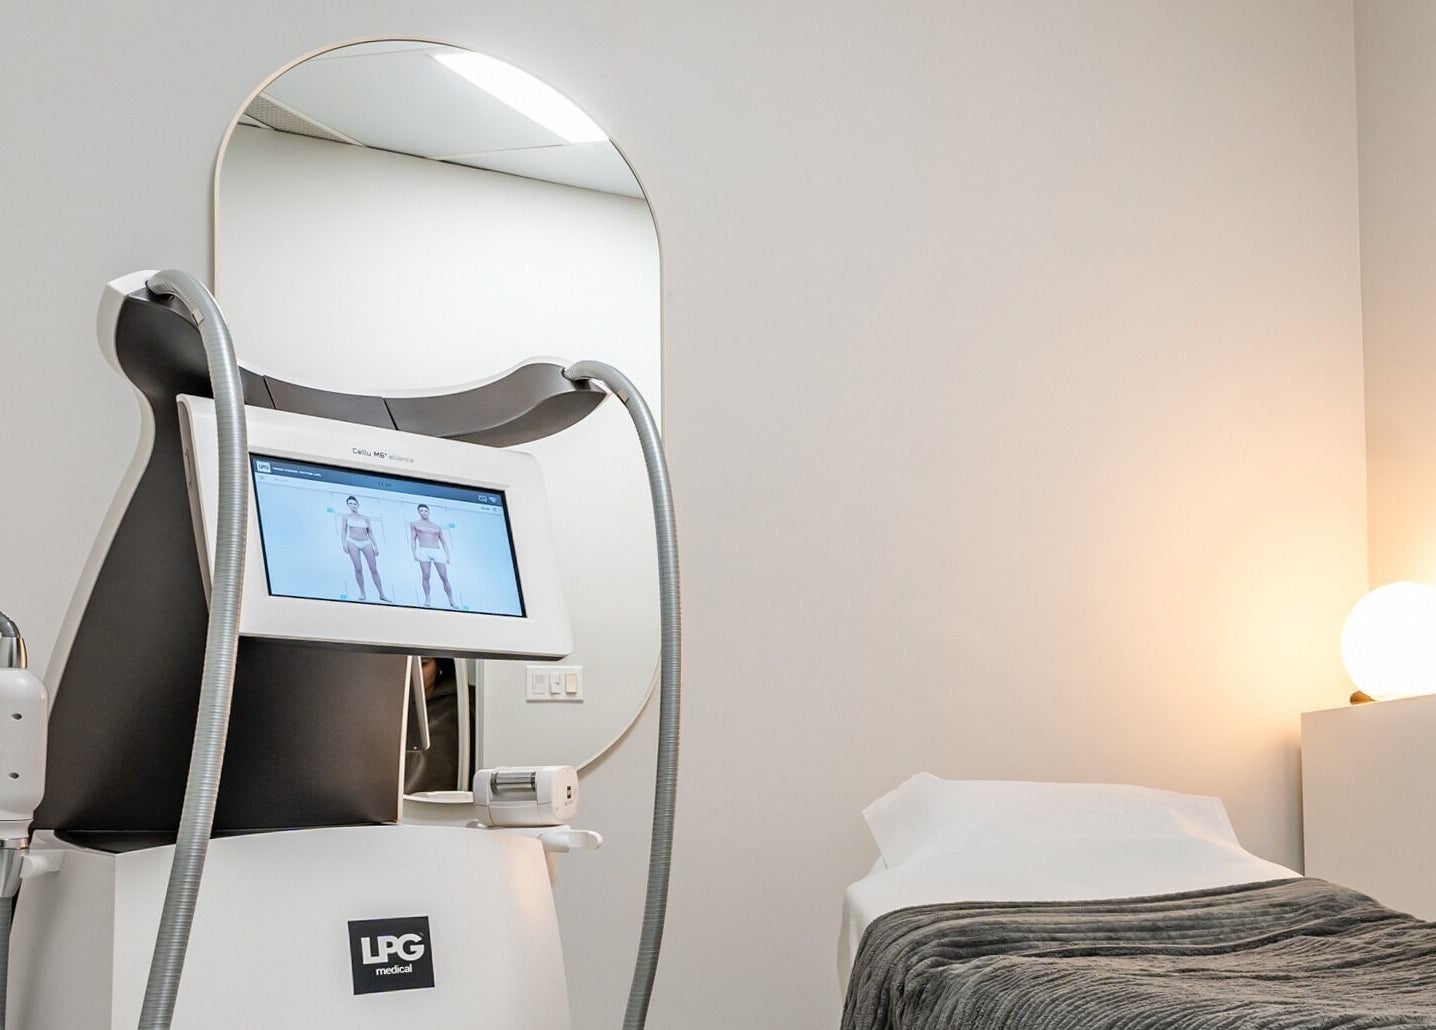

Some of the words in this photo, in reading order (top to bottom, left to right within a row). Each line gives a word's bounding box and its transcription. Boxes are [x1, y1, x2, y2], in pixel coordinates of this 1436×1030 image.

[352, 447, 372, 457] Cellu
[361, 933, 425, 965] LPG
[375, 963, 413, 976] medical
